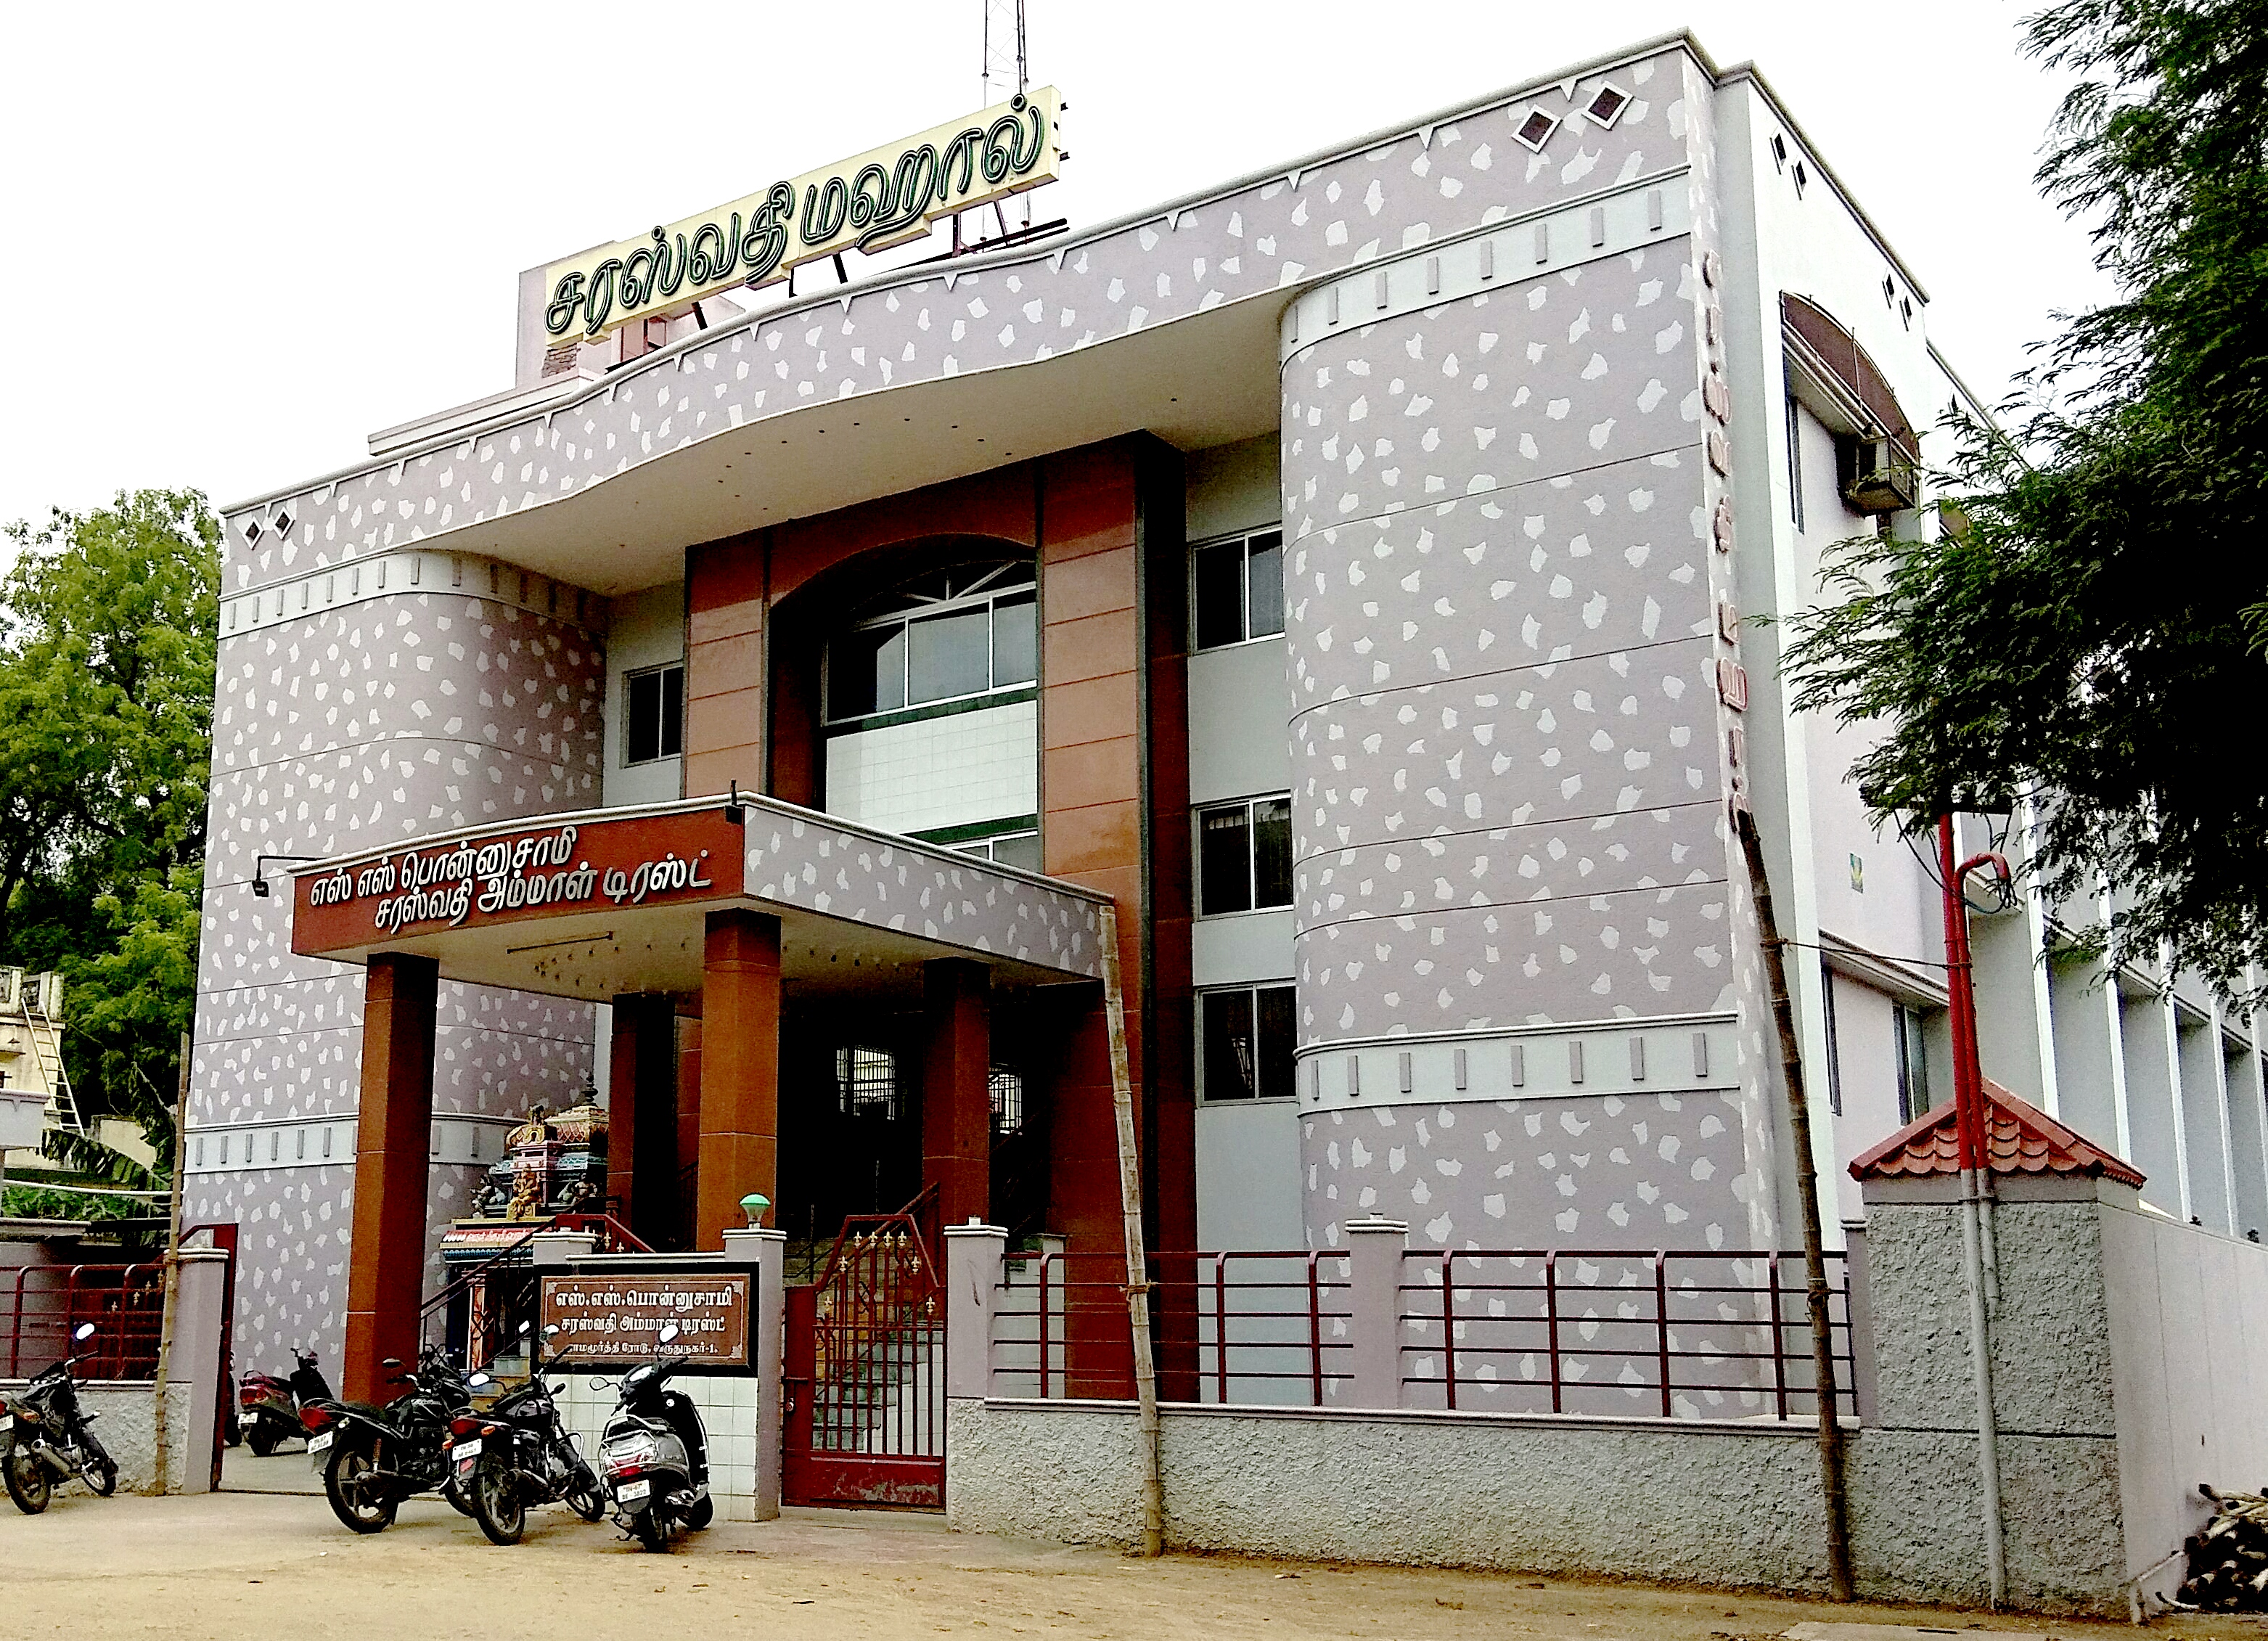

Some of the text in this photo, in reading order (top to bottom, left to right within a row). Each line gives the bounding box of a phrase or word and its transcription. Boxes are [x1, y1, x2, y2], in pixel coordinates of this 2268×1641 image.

[544, 94, 1046, 335] சரஸ்வதி மஹால்
[310, 826, 577, 907] எஸ் எஸ் பொன்னுசாமி
[374, 849, 712, 934] சரஸ்வதி அம்மாள் டிரஸ்ட்
[561, 1311, 617, 1335] சரஸ்வதி
[681, 1311, 726, 1335] டிரஸ்ட்
